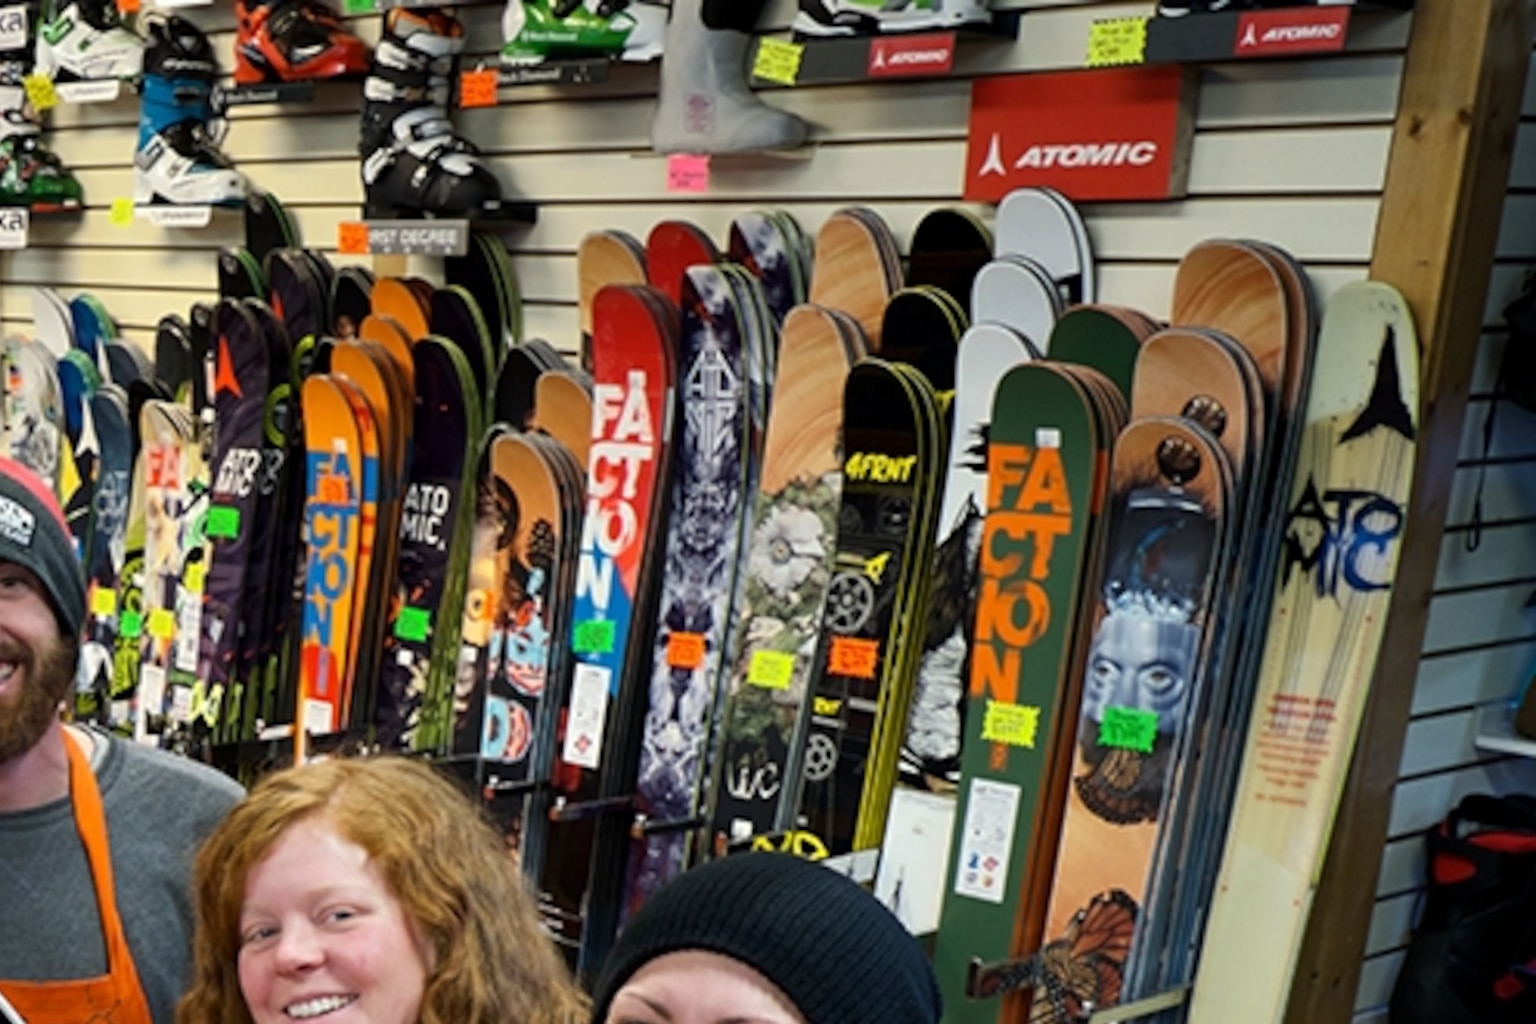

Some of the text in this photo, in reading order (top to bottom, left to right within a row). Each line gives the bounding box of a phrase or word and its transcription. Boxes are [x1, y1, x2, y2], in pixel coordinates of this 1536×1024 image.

[1262, 24, 1340, 42] ATOMIC
[1015, 141, 1156, 169] ATOMIC
[400, 228, 457, 246] DEGREE
[845, 452, 917, 482] 4FRNT
